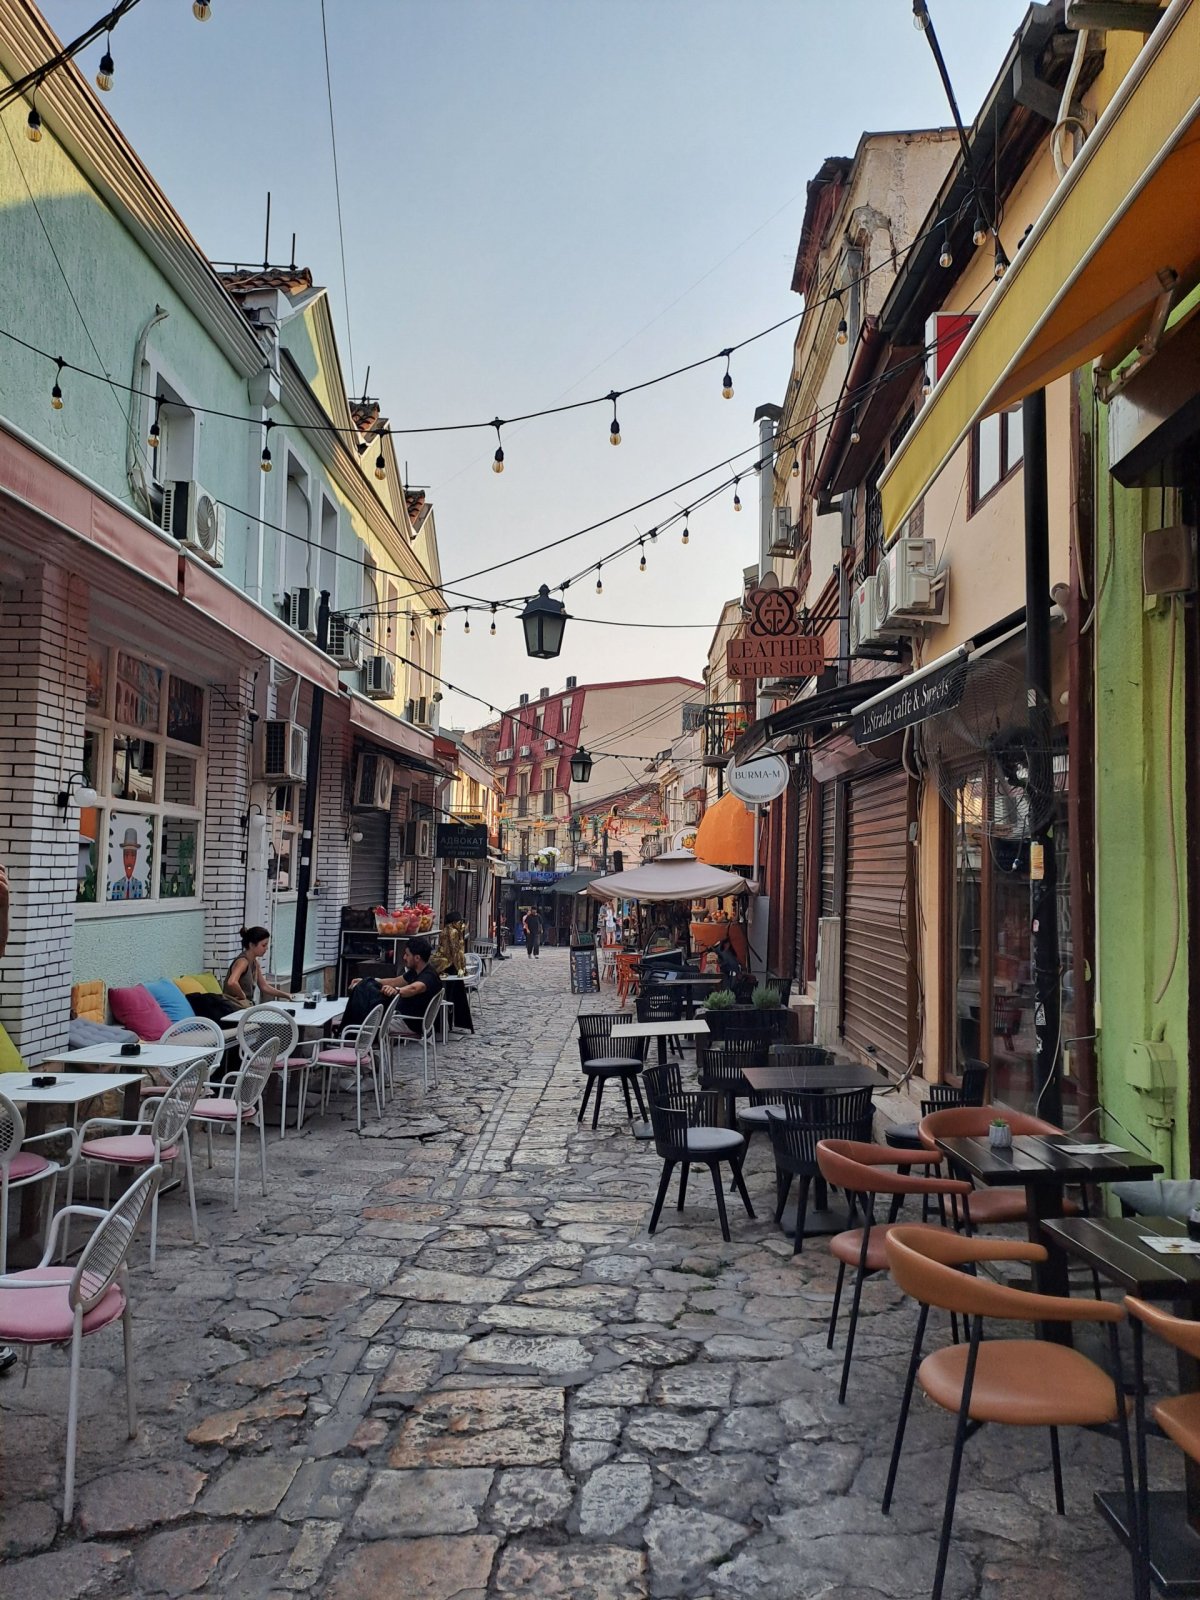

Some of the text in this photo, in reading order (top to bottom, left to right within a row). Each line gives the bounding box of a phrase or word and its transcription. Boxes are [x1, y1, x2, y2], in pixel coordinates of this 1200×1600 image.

[730, 640, 820, 658] LEATHER
[780, 660, 822, 674] SHOP
[913, 689, 920, 711] &
[735, 770, 780, 780] BURMA-M
[440, 836, 483, 845] АДВОКАТ
